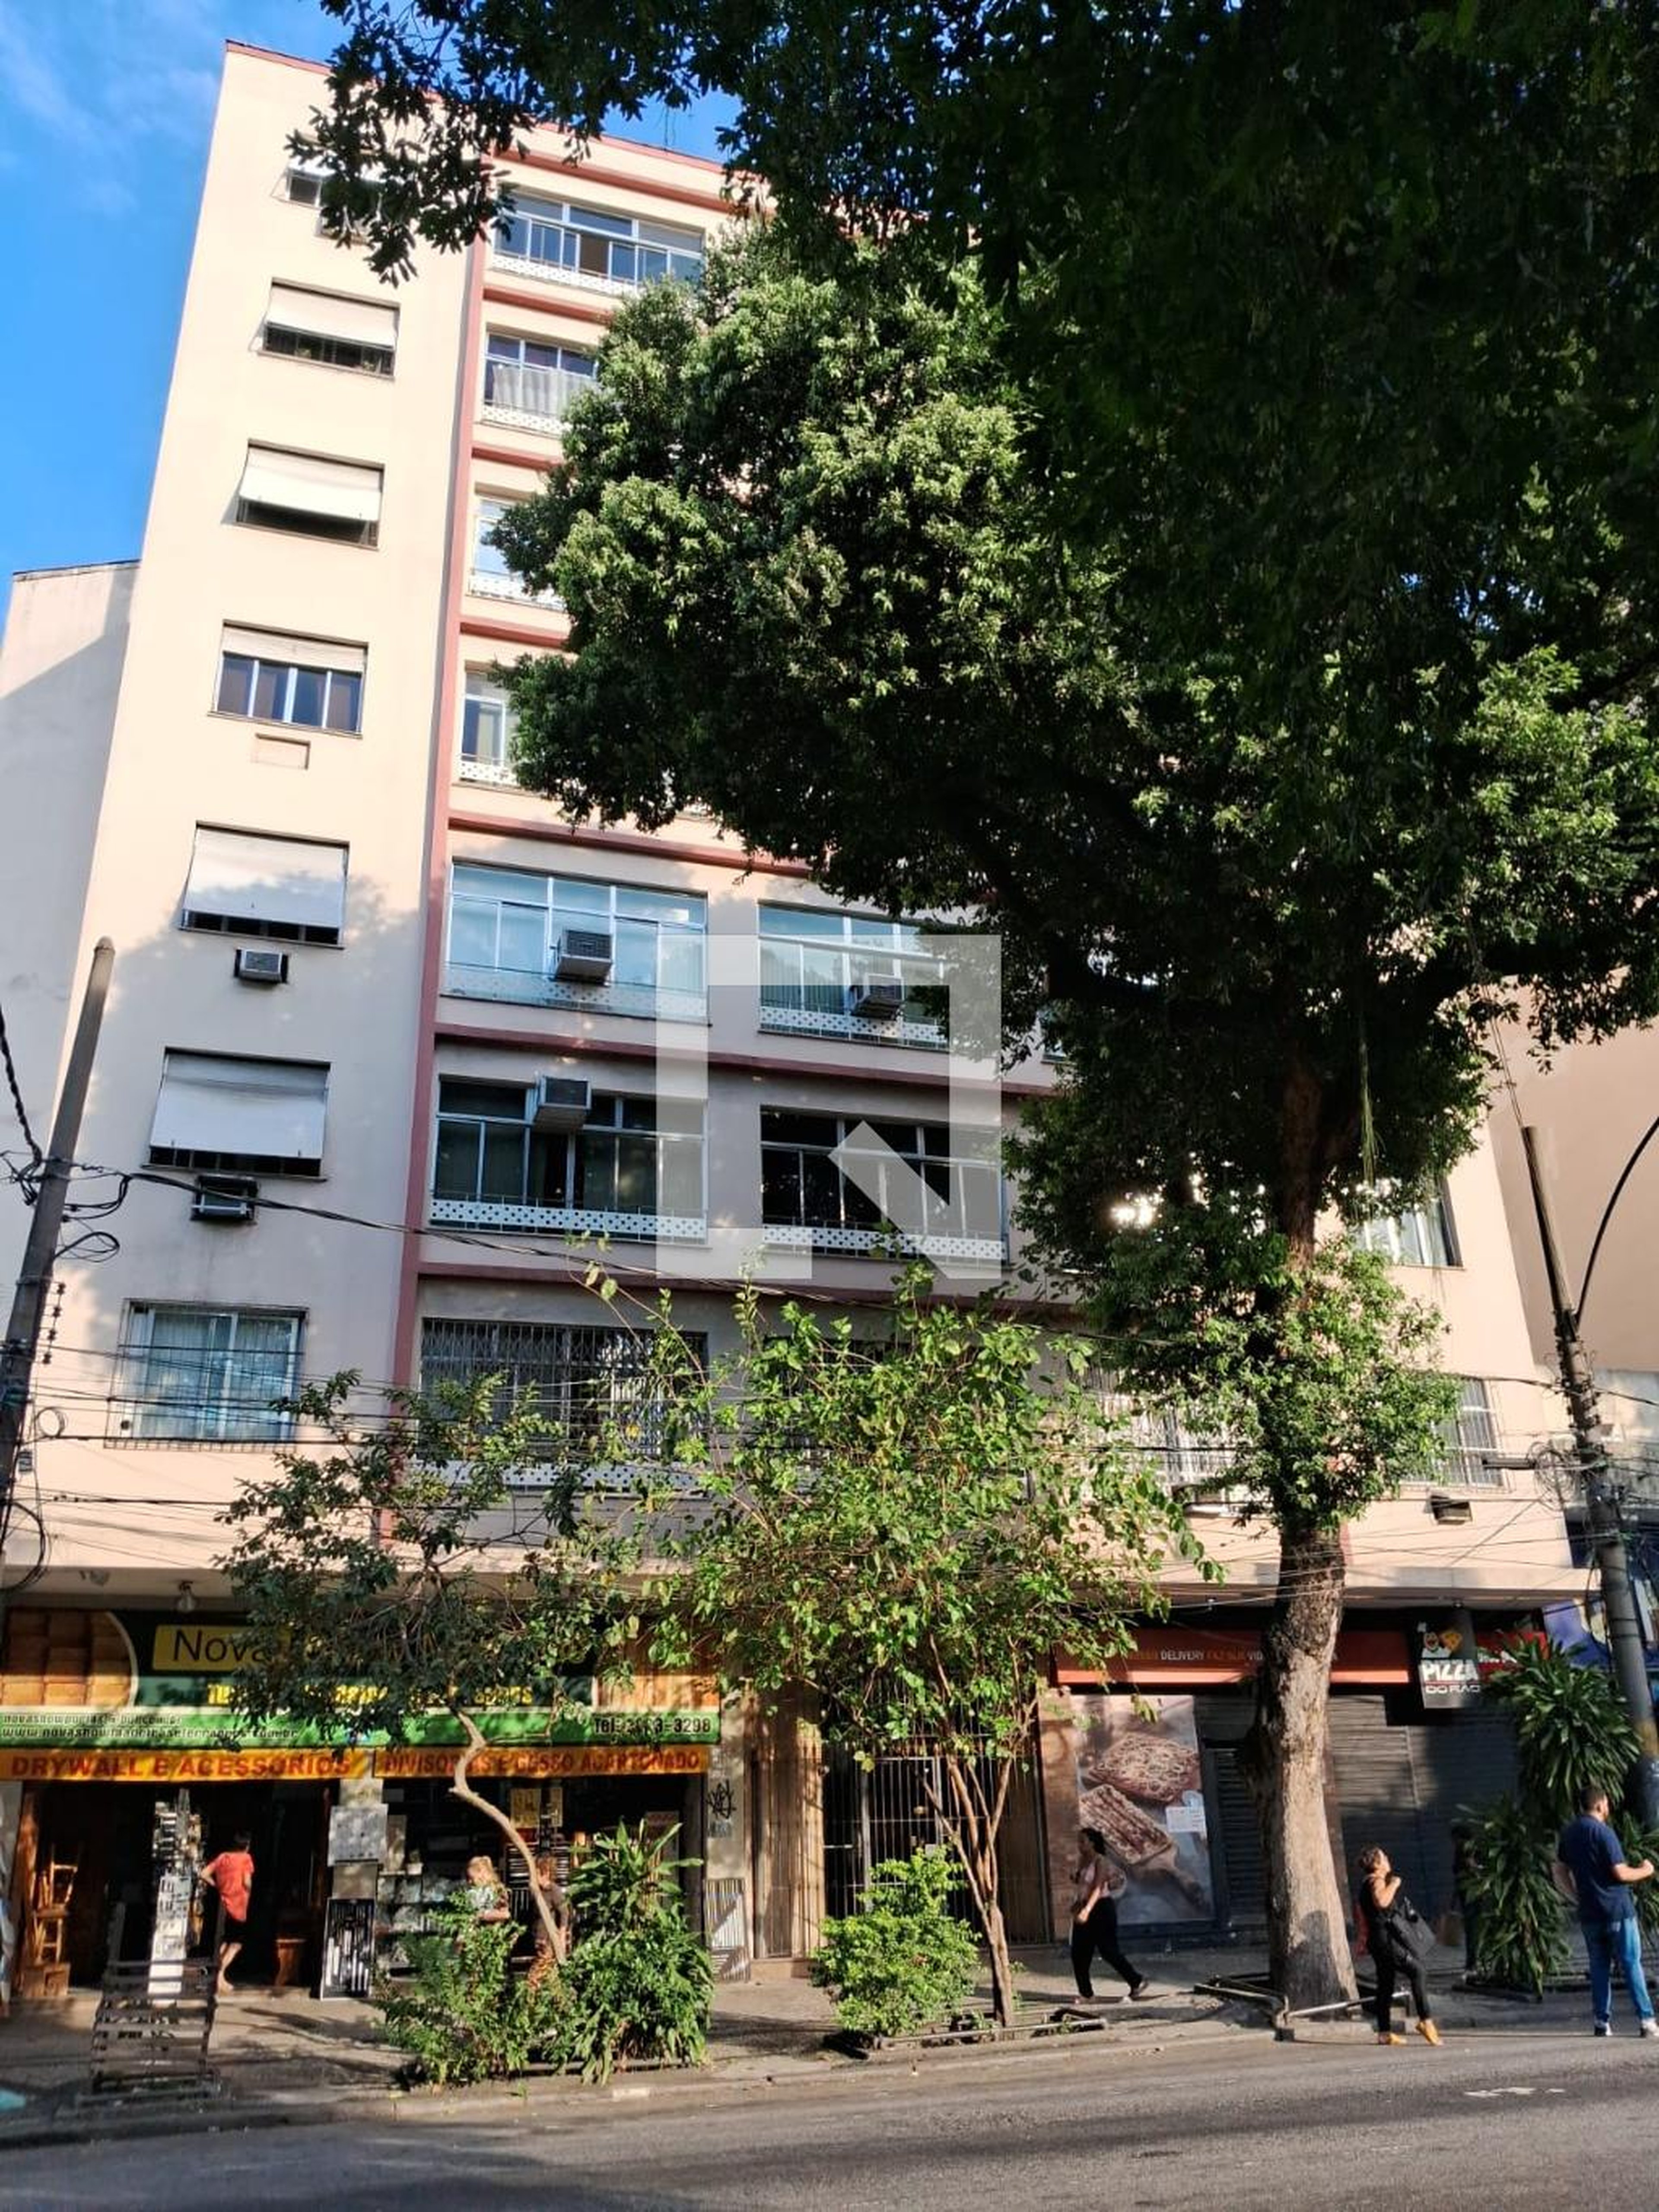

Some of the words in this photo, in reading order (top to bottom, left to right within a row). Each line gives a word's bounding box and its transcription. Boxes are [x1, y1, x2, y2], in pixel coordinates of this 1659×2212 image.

[1161, 1649, 1204, 1660] DELIVERY
[1421, 1659, 1479, 1681] PIZZA
[11, 1756, 143, 1776] DRYWALL
[153, 1756, 169, 1774] E
